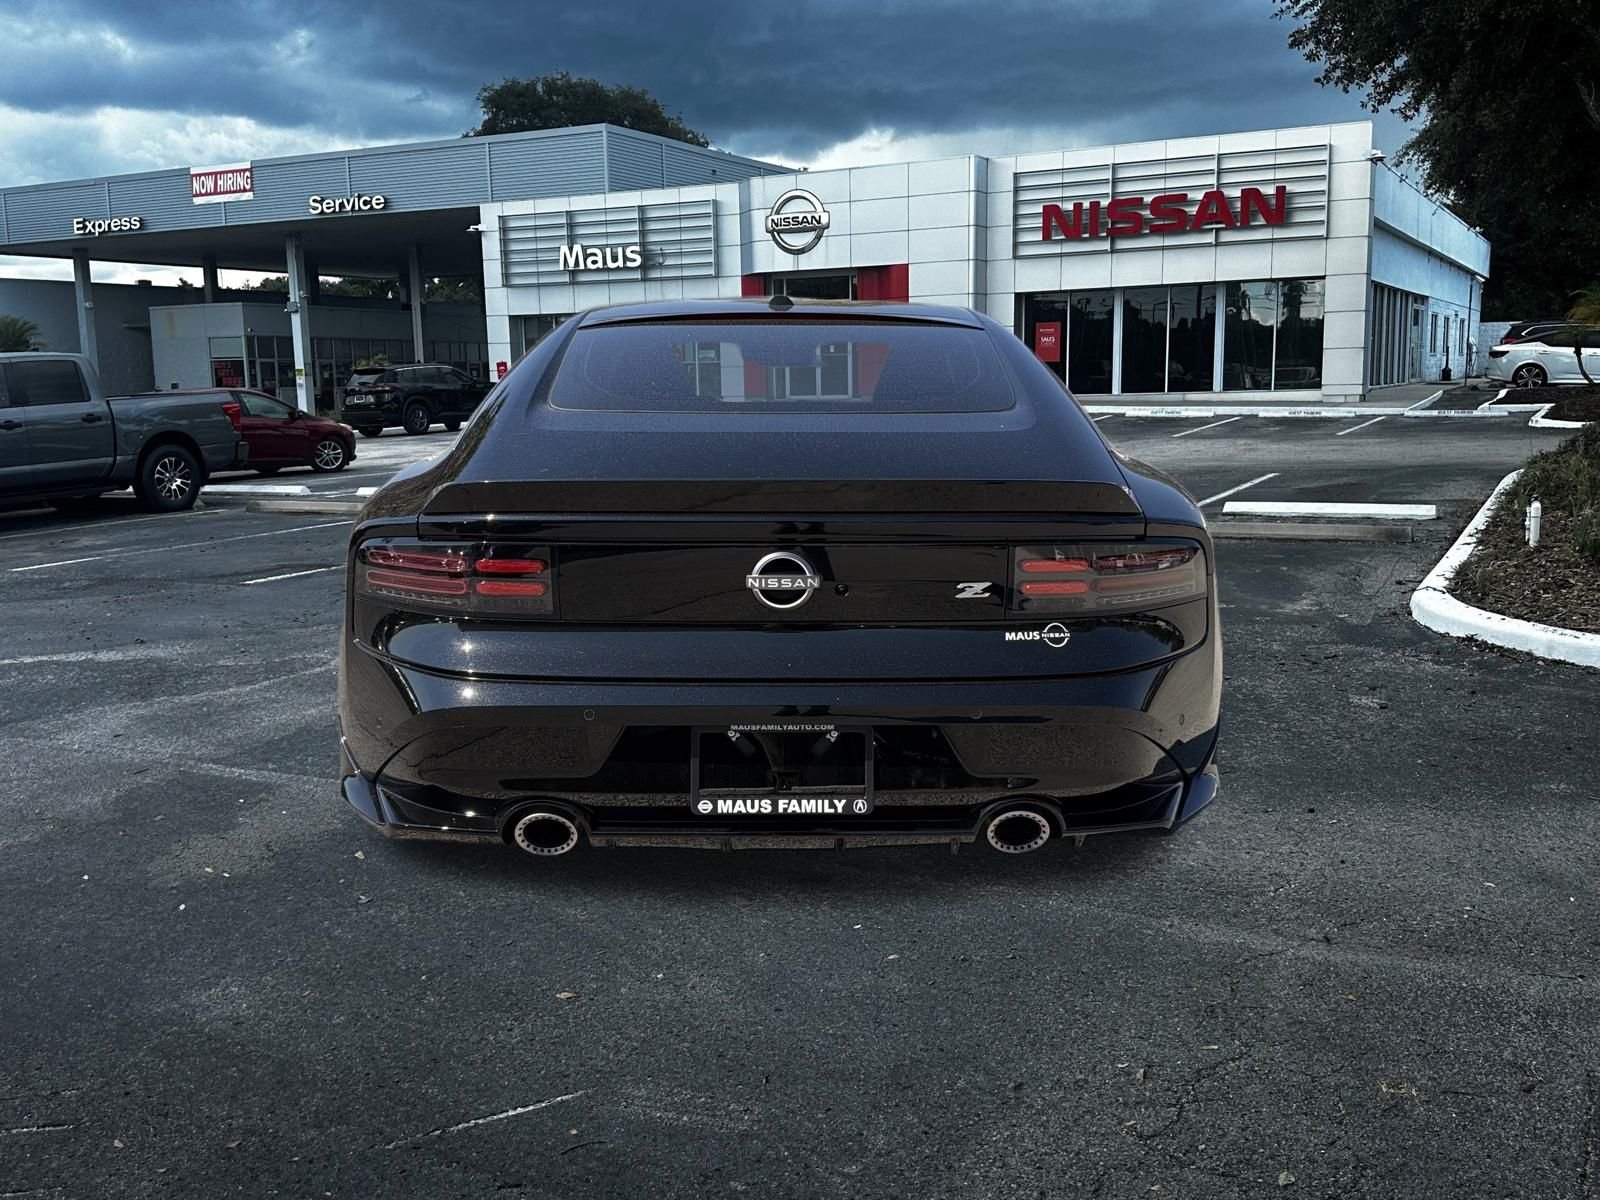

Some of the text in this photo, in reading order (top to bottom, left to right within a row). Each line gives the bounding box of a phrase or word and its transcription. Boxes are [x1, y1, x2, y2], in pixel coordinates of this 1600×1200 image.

[192, 171, 251, 195] NOW HIRING
[309, 193, 385, 214] Service
[770, 214, 822, 229] NISSAN
[1041, 185, 1287, 241] NISSAN
[73, 217, 141, 236] Express
[559, 243, 642, 271] Maus
[748, 576, 819, 588] NISSAN
[954, 581, 993, 599] Z
[1005, 631, 1040, 641] MAUS
[717, 799, 847, 814] MAUS FAMILY
